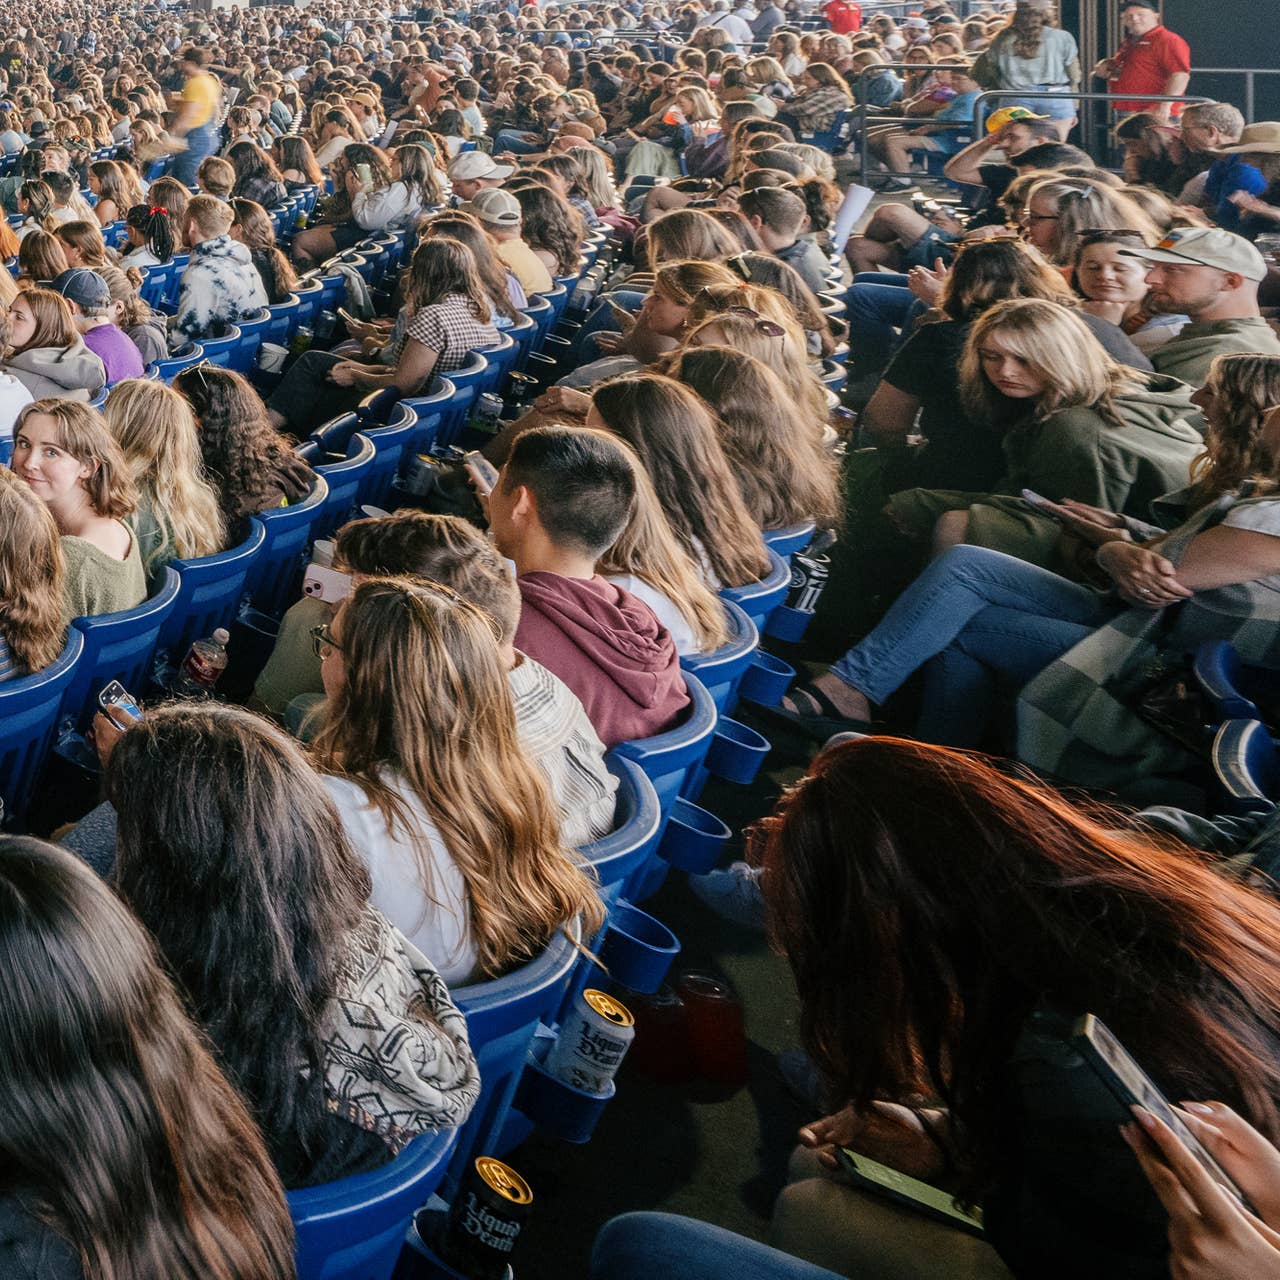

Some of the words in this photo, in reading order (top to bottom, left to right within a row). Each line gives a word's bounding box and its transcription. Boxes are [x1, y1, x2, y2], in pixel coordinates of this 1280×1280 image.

[576, 1037, 620, 1065] Death
[579, 1020, 627, 1053] Liquid
[461, 1211, 515, 1252] Death
[465, 1191, 522, 1237] Liquid
